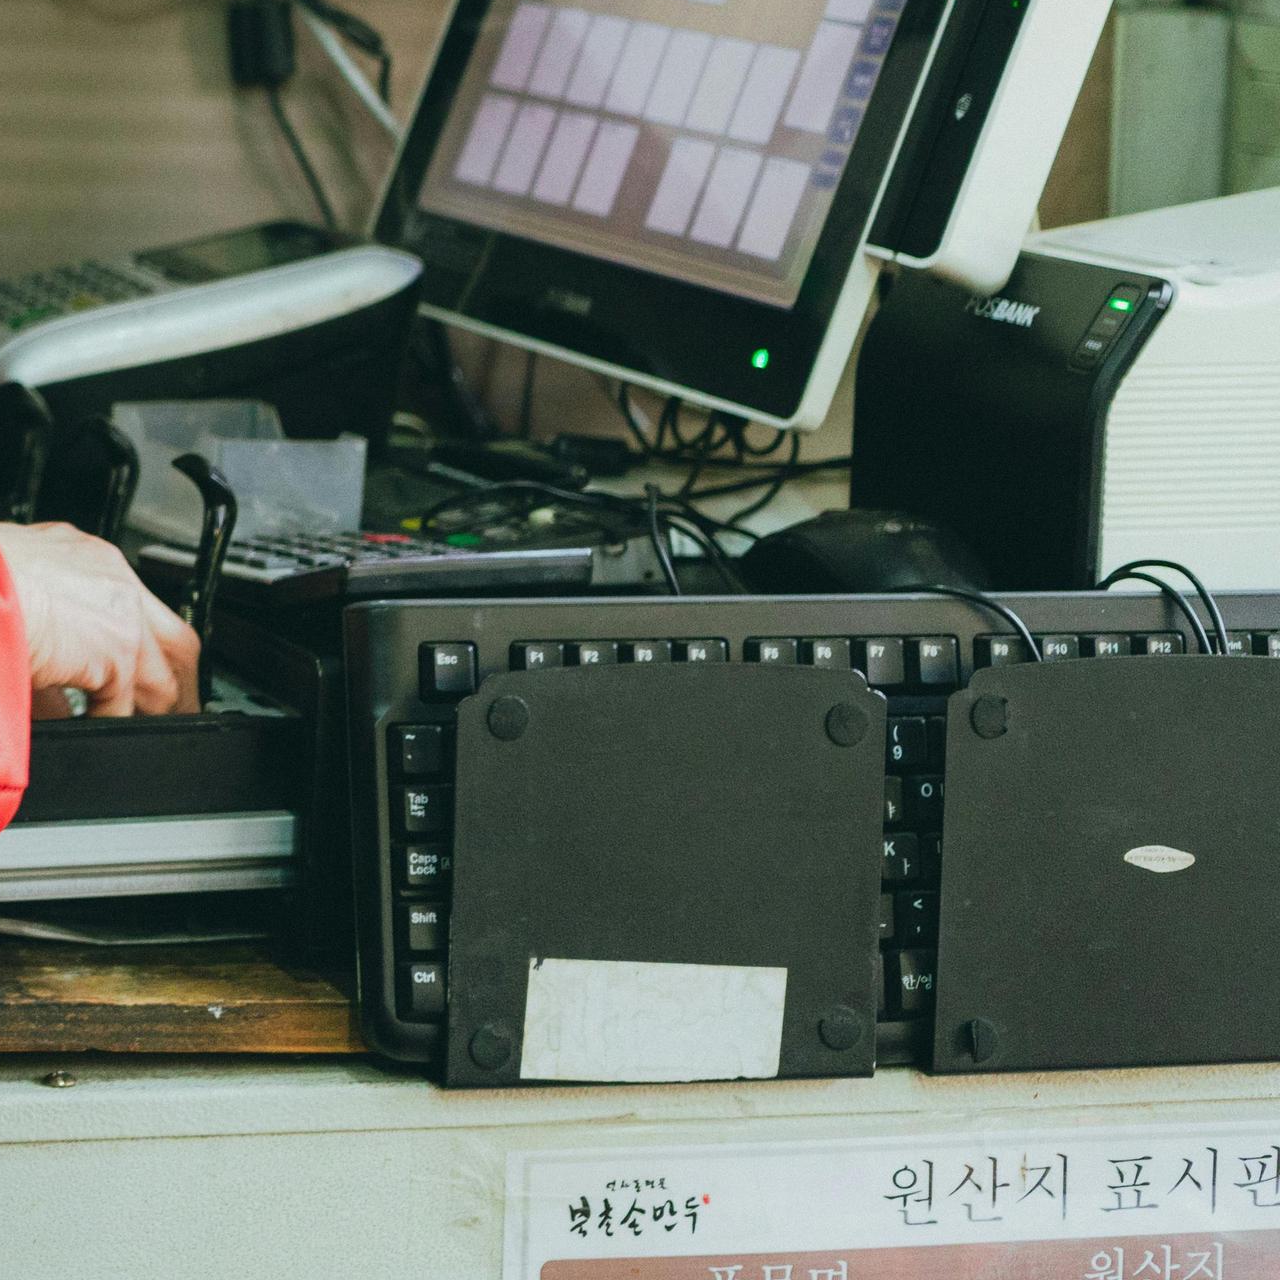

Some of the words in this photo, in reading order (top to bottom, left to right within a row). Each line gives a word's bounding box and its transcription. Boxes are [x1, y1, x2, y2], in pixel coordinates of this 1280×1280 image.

[692, 648, 707, 660] F4
[764, 647, 779, 660] F5
[817, 646, 832, 659] F6
[870, 645, 885, 658] F7
[923, 644, 938, 657] F8
[993, 643, 1008, 656] F9
[1046, 643, 1068, 656] F10
[1099, 642, 1119, 654] F11
[1151, 641, 1172, 654] F12
[437, 652, 458, 666] Esc
[530, 650, 544, 663] F1
[583, 649, 599, 663] F2
[637, 648, 652, 662] F3
[893, 746, 903, 760] 9
[408, 792, 429, 804] Tab
[884, 841, 896, 856] K
[409, 852, 438, 865] Caps
[409, 865, 437, 875] Lock
[411, 912, 438, 924] Shift
[413, 971, 436, 984] Ctrl
[902, 974, 933, 991] 한/영
[883, 1152, 1069, 1226] 원산지
